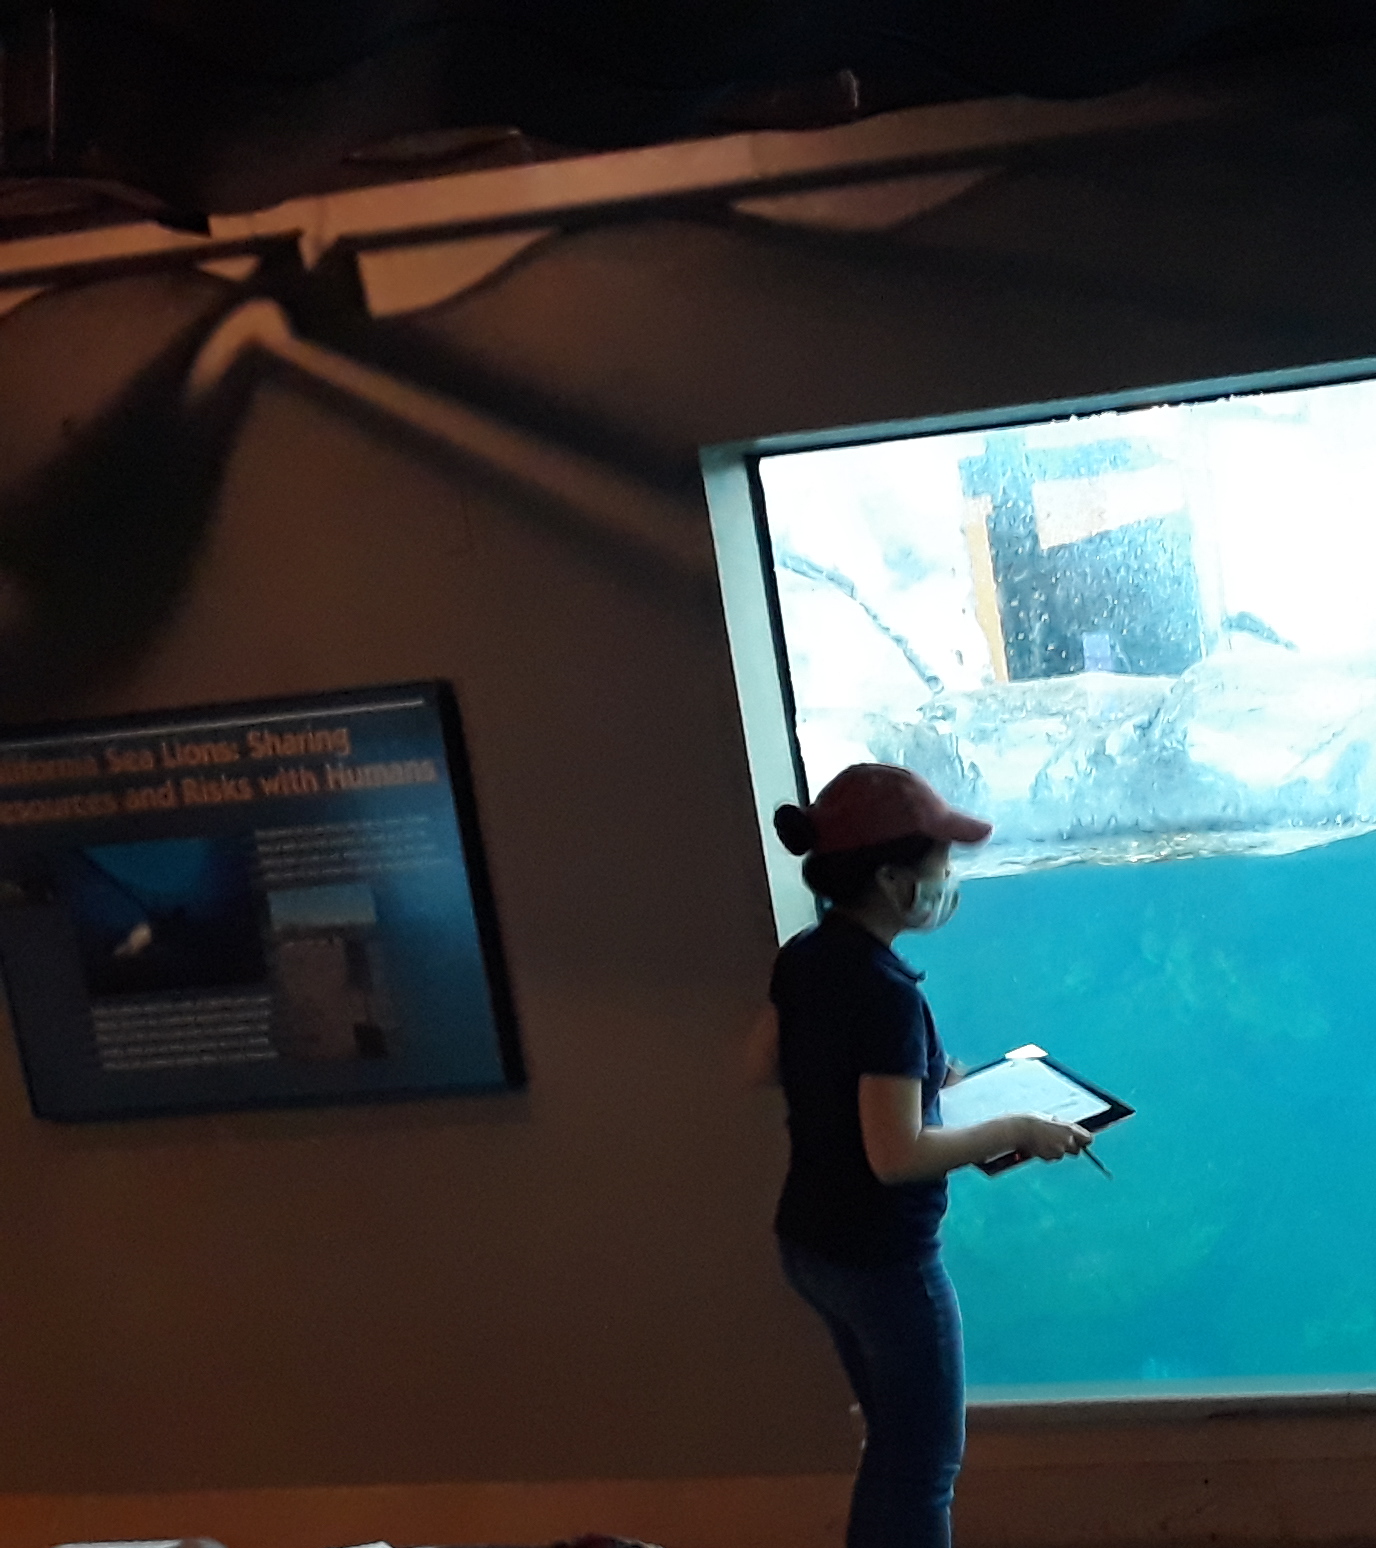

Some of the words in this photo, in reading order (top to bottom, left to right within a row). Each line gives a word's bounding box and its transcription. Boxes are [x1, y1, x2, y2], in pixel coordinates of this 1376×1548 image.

[106, 748, 155, 772] Sea
[248, 726, 350, 757] Sharing
[124, 780, 177, 808] and
[182, 775, 251, 802] Risks
[260, 767, 318, 795] with
[326, 760, 436, 788] Humans
